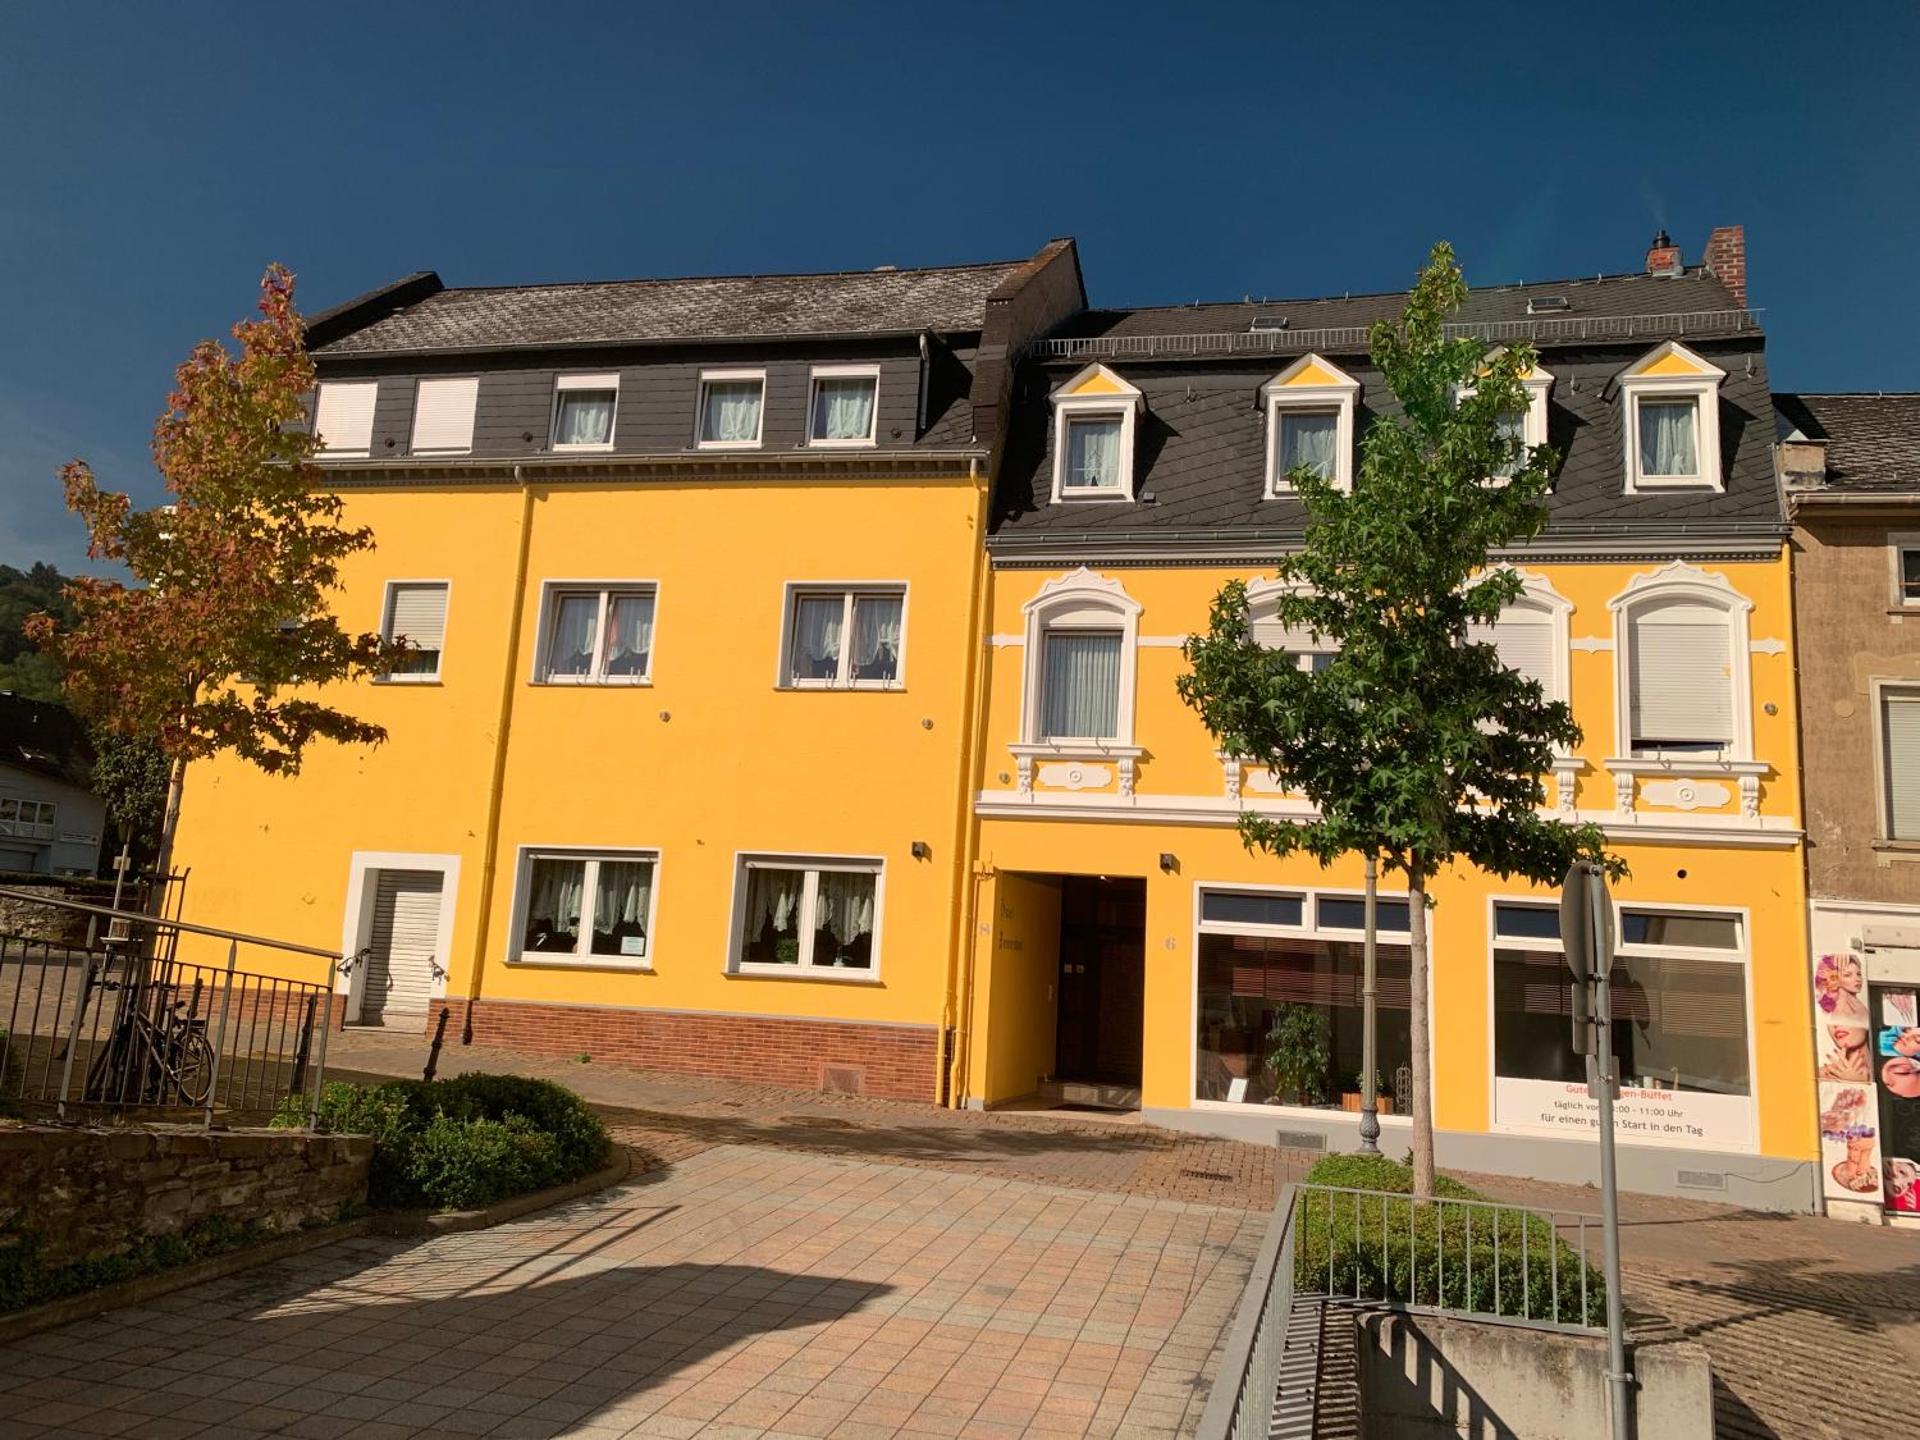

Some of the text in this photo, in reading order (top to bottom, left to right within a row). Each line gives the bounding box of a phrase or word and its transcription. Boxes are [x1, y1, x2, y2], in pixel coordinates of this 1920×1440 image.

[1165, 937, 1176, 950] 6
[1566, 1084, 1673, 1101] Gute en-Buffet
[1554, 1101, 1584, 1112] täglich
[1610, 1105, 1630, 1114] :00
[1640, 1107, 1664, 1117] 11:00
[1667, 1109, 1684, 1118] Uhr
[1541, 1113, 1704, 1137] für einen gun Start in den Tag
